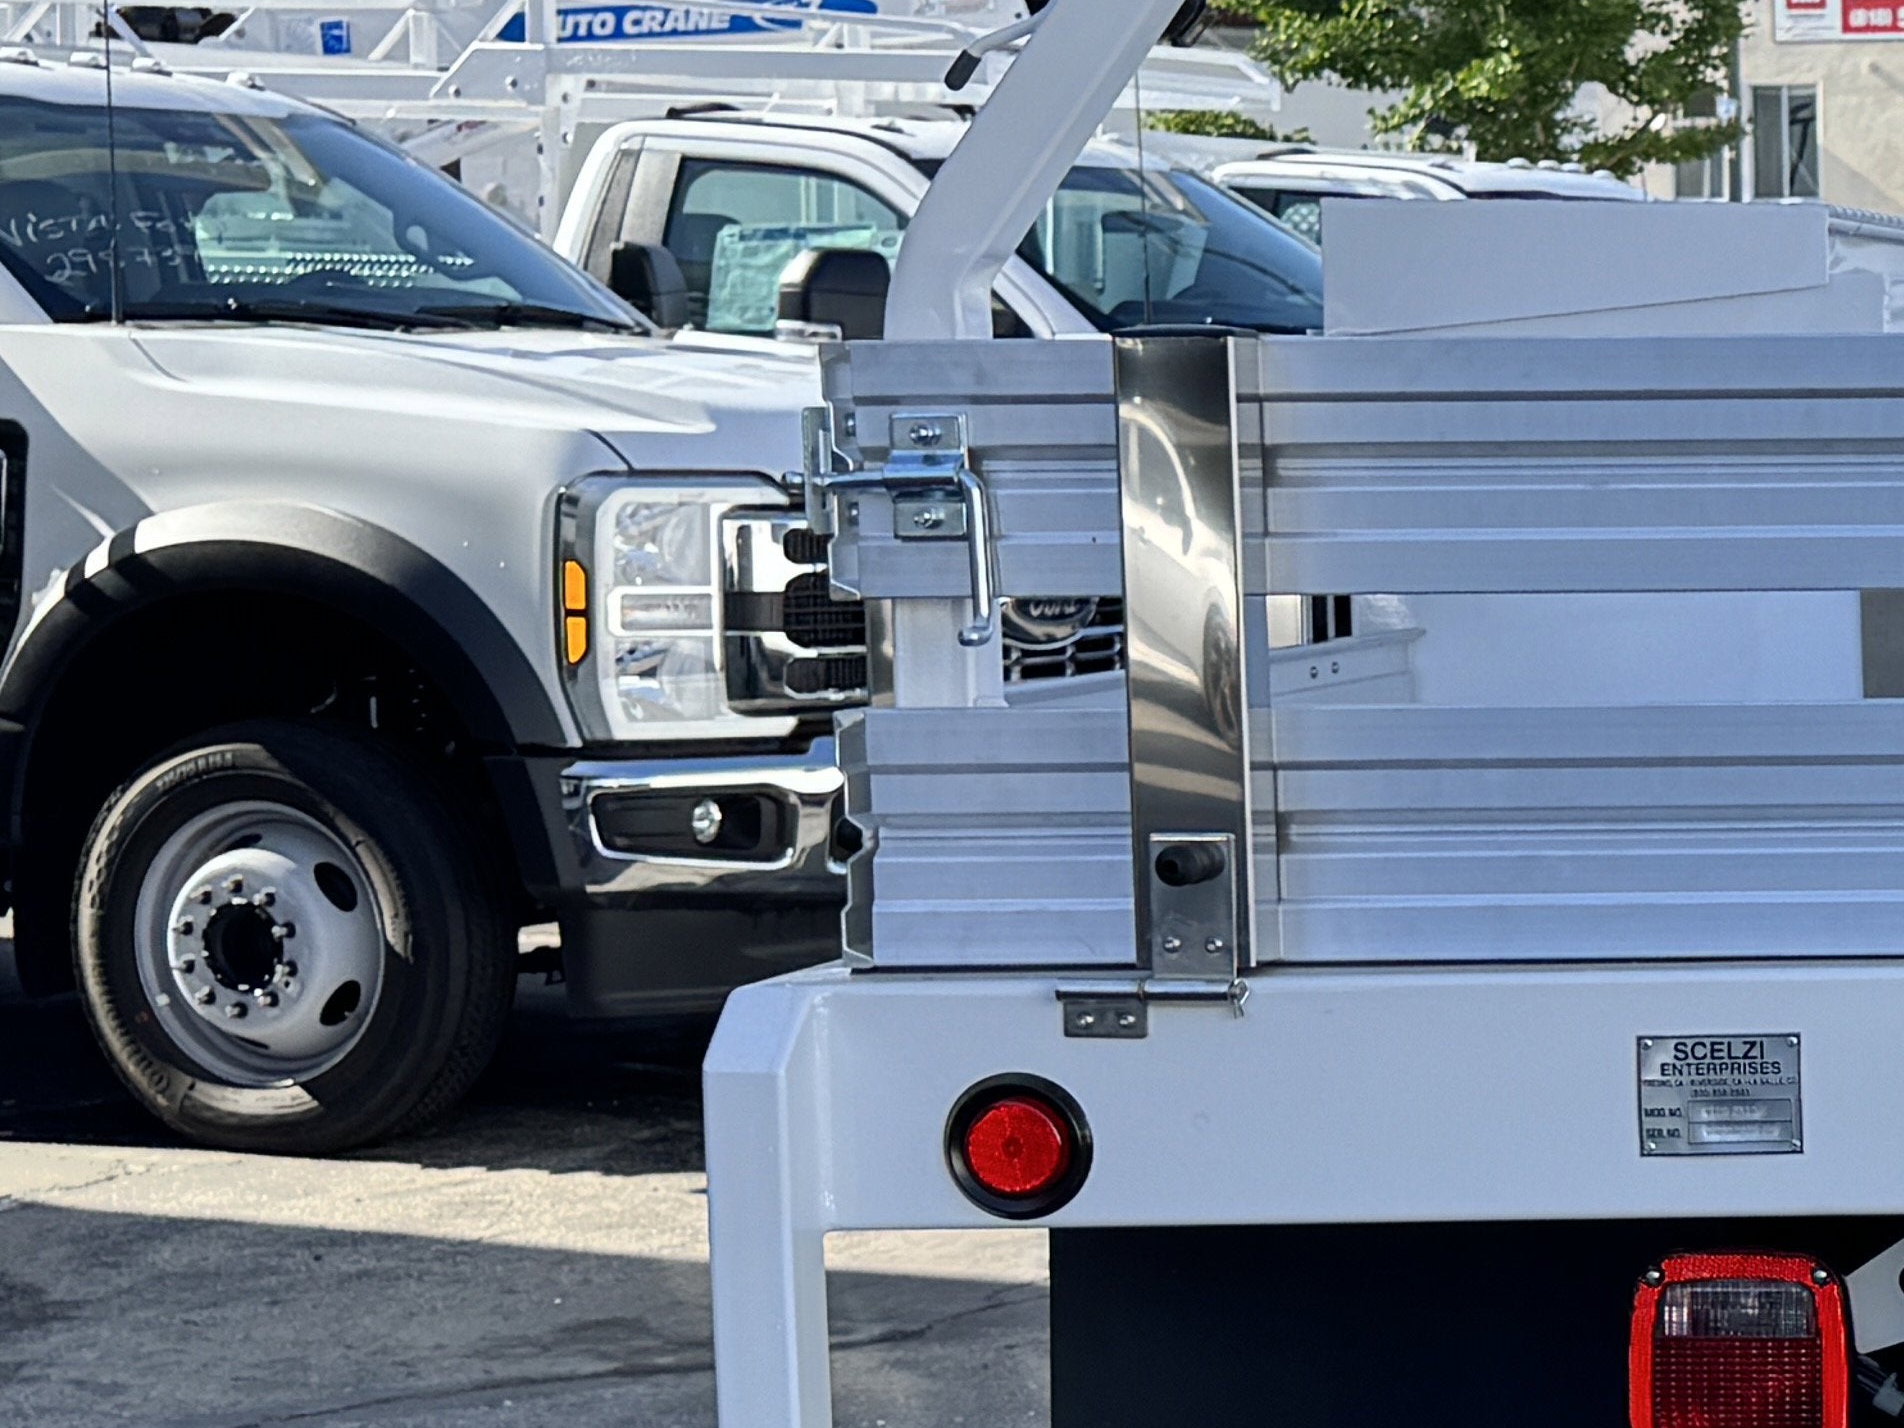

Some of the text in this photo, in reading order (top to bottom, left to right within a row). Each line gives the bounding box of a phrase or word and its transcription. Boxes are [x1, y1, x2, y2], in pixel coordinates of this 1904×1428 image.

[557, 8, 732, 39] UTO CRANE
[1673, 1040, 1765, 1061] SCELZI
[1660, 1061, 1782, 1077] ENTERPRISES
